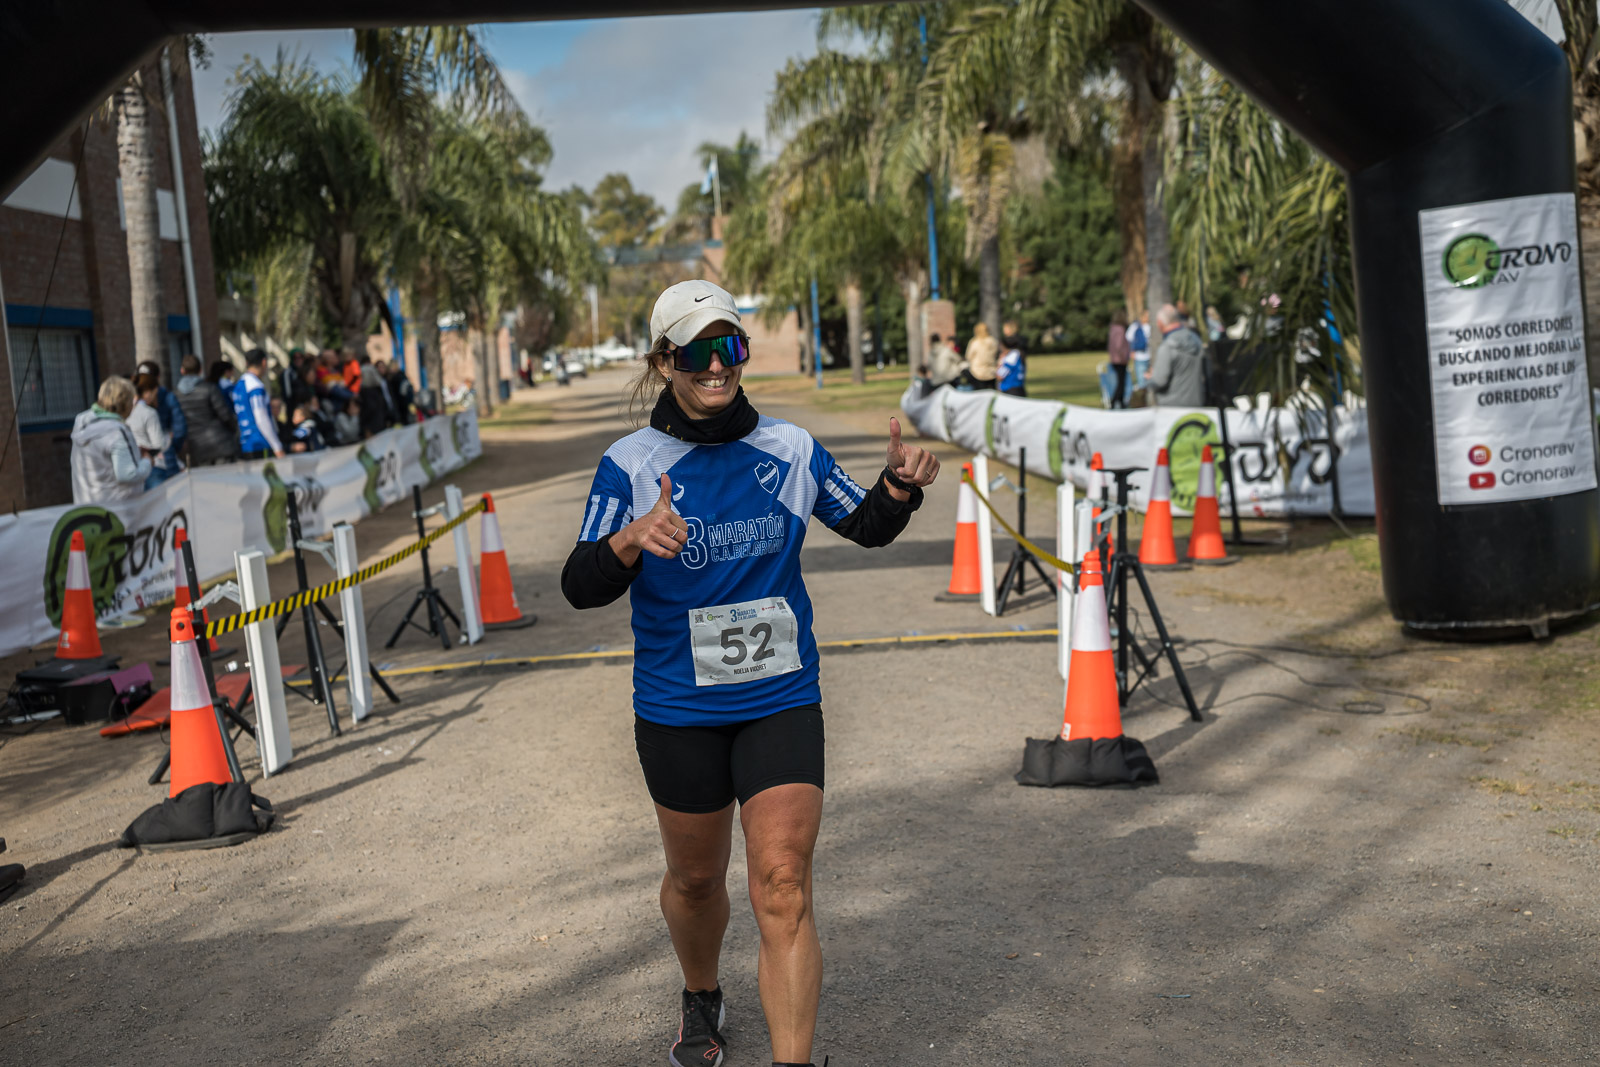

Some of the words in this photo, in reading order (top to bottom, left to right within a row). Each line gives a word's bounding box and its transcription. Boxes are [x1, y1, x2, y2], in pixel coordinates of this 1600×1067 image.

[1505, 316, 1573, 338] CORREDORES
[1439, 346, 1510, 366] BUSCANDO
[1514, 339, 1567, 359] MEJORAR
[1568, 338, 1581, 351] LAS
[1453, 364, 1543, 386] EXPERIENCIAS
[1546, 362, 1559, 376] DE
[1562, 360, 1576, 374] LOS
[1500, 442, 1575, 462] Cronorav
[1501, 465, 1576, 485] Cronorav
[708, 512, 784, 547] MARATÓN
[680, 517, 708, 569] 3
[729, 609, 737, 622] 3
[721, 622, 775, 665] 52
